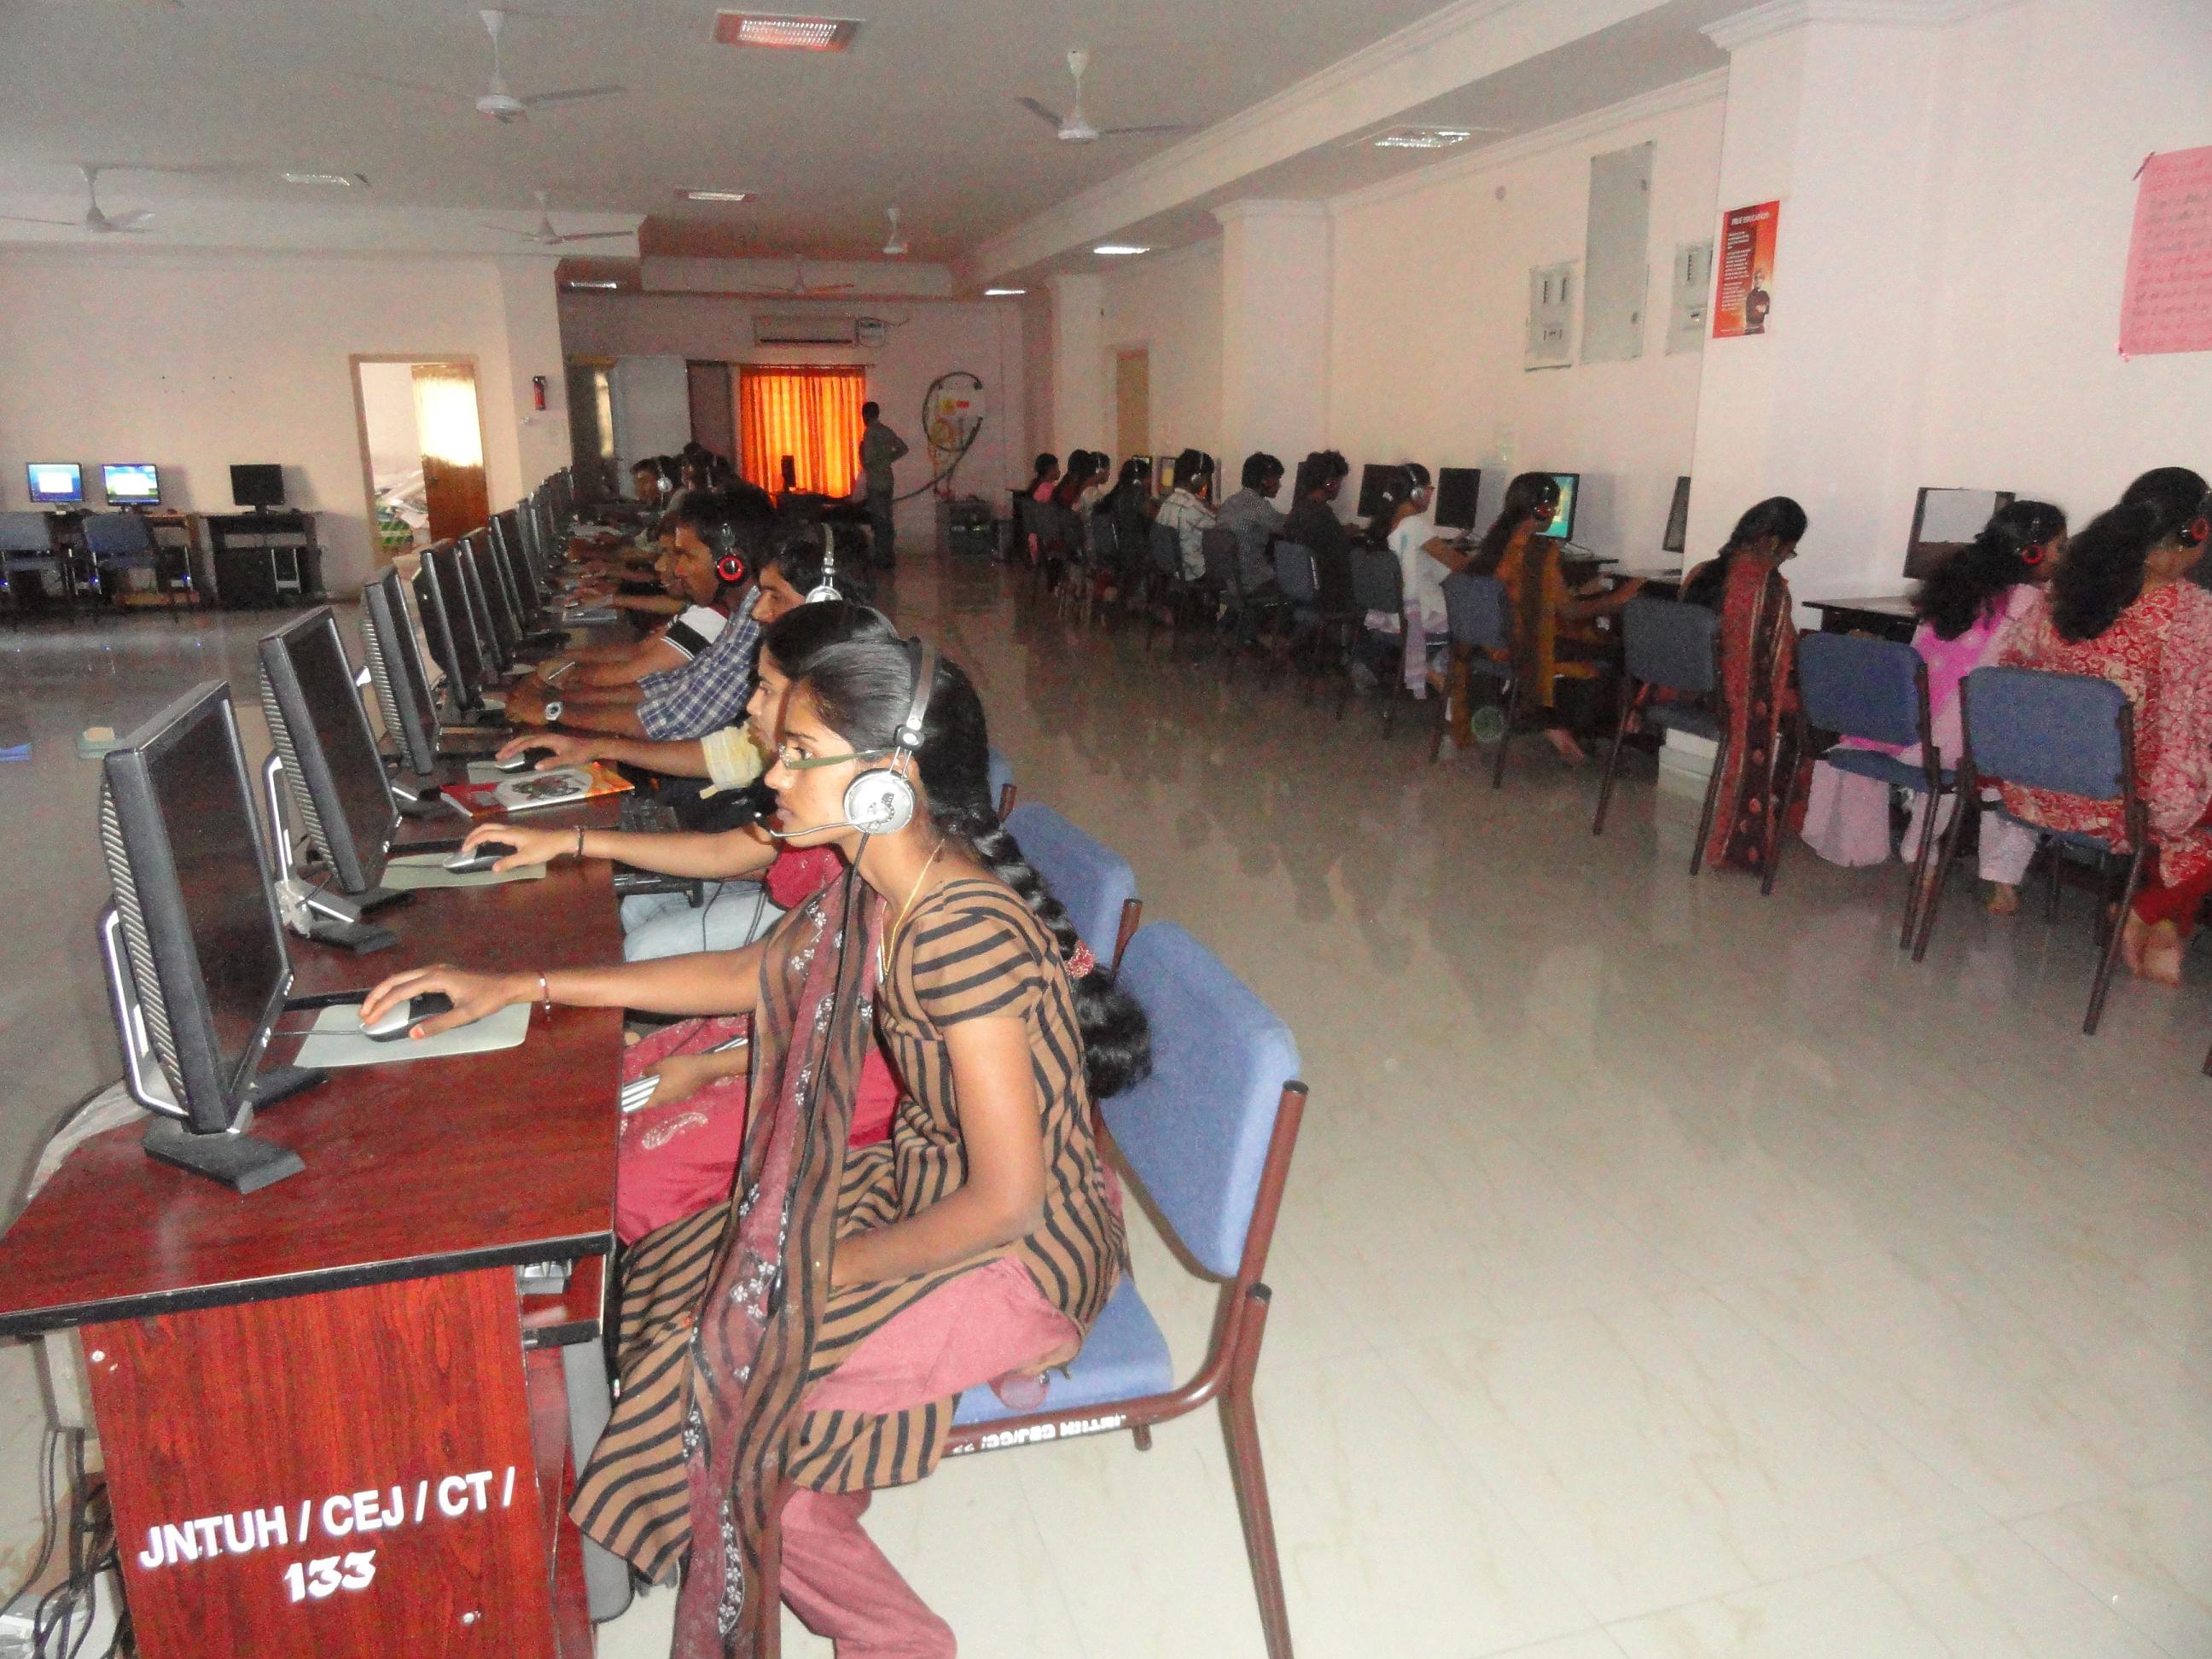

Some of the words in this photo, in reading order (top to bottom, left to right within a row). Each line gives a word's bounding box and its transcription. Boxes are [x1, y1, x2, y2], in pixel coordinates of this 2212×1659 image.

[138, 1505, 289, 1569] JNTUH
[322, 1486, 405, 1537] CEJ
[438, 1470, 493, 1517] CT
[282, 1549, 376, 1603] 133
